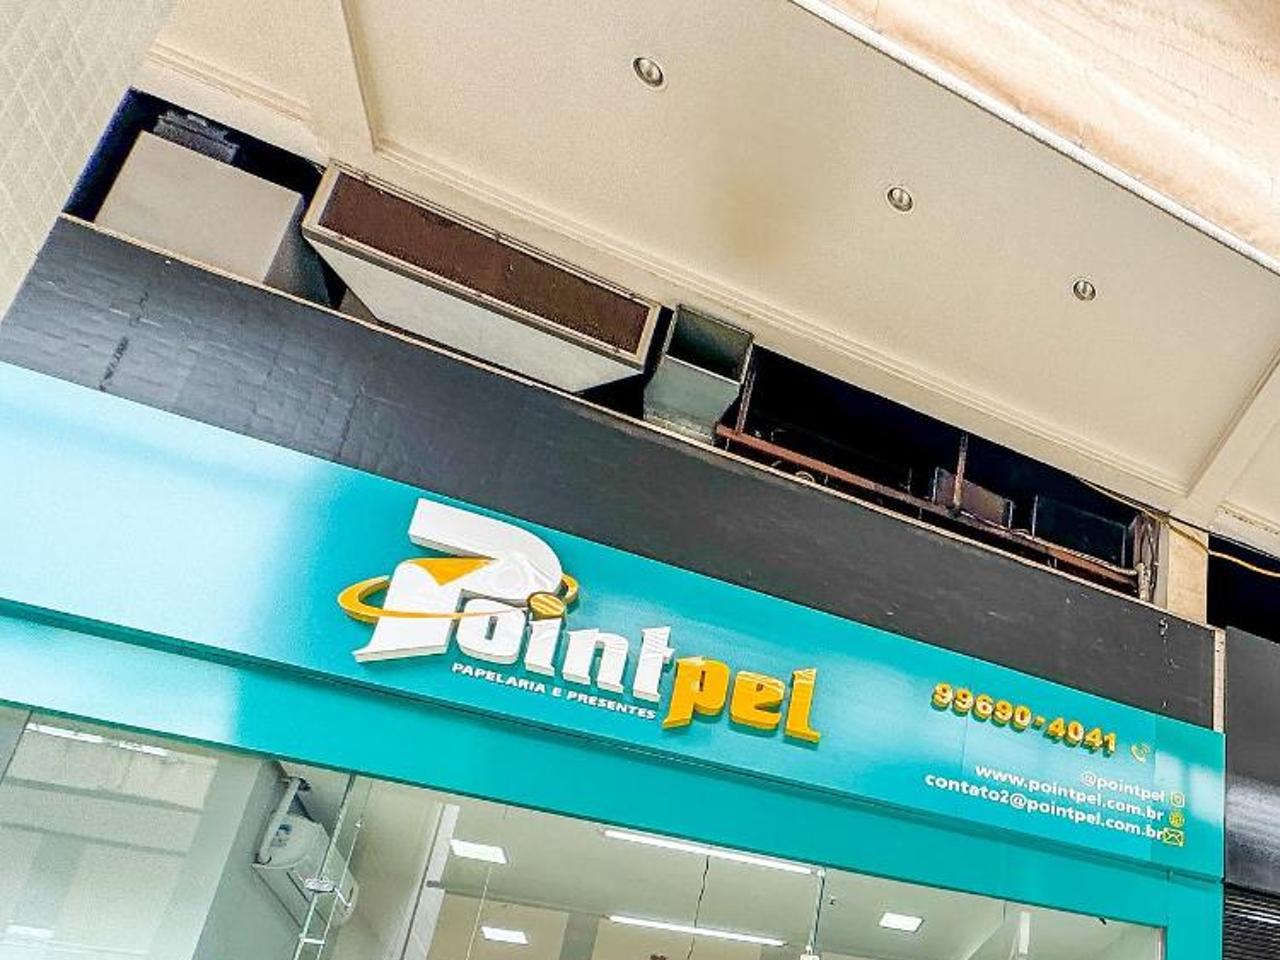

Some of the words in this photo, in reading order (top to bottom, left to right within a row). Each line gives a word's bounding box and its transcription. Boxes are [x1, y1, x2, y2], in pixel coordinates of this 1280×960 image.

[452, 662, 546, 694] PAPELARIA
[552, 687, 564, 698] E
[566, 690, 657, 720] PRESENTES
[931, 682, 1118, 754] 99690-4041
[924, 772, 1163, 841] contato2@pointpel.com.br
[975, 764, 1164, 822] www.pointpel.com.br
[1080, 770, 1166, 804] @pointpel
